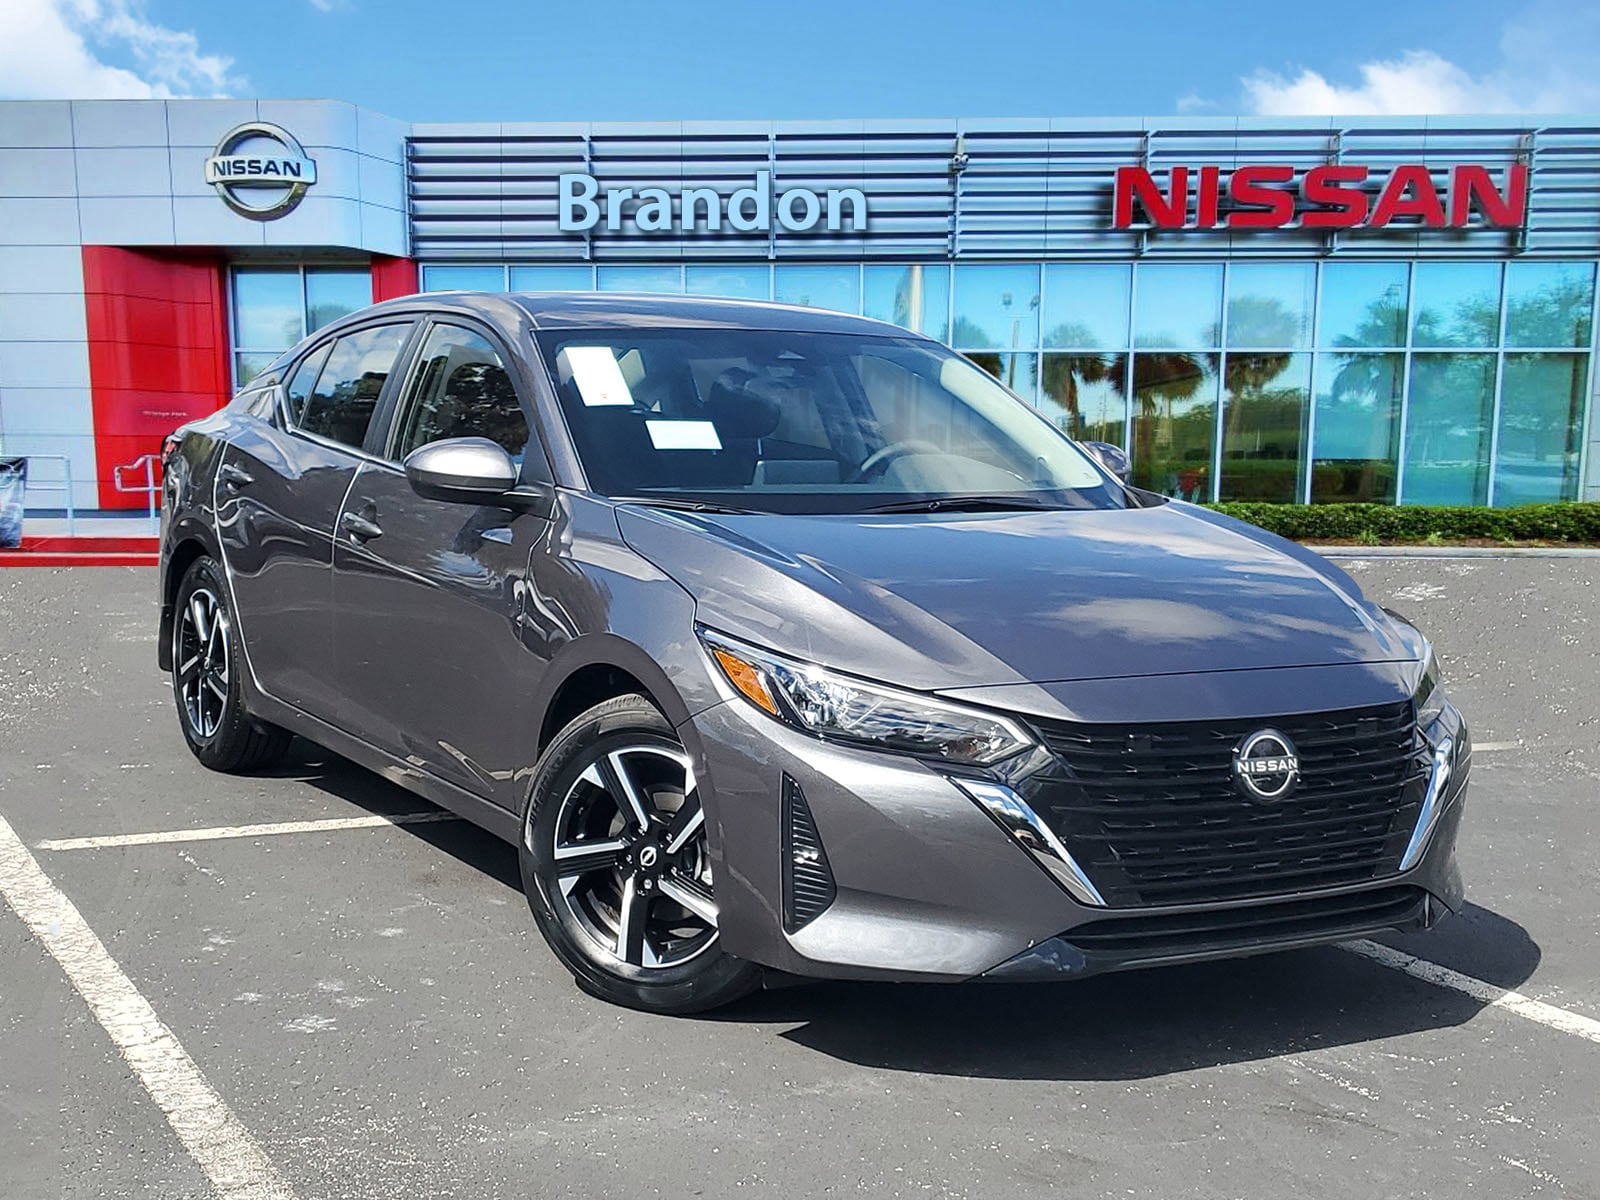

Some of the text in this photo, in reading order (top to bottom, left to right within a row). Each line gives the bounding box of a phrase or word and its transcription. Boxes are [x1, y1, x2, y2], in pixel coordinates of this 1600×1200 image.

[212, 159, 301, 177] NISSAN
[558, 170, 868, 232] Brandon
[1113, 164, 1528, 229] NISSAN
[1237, 758, 1298, 773] NISSAN
